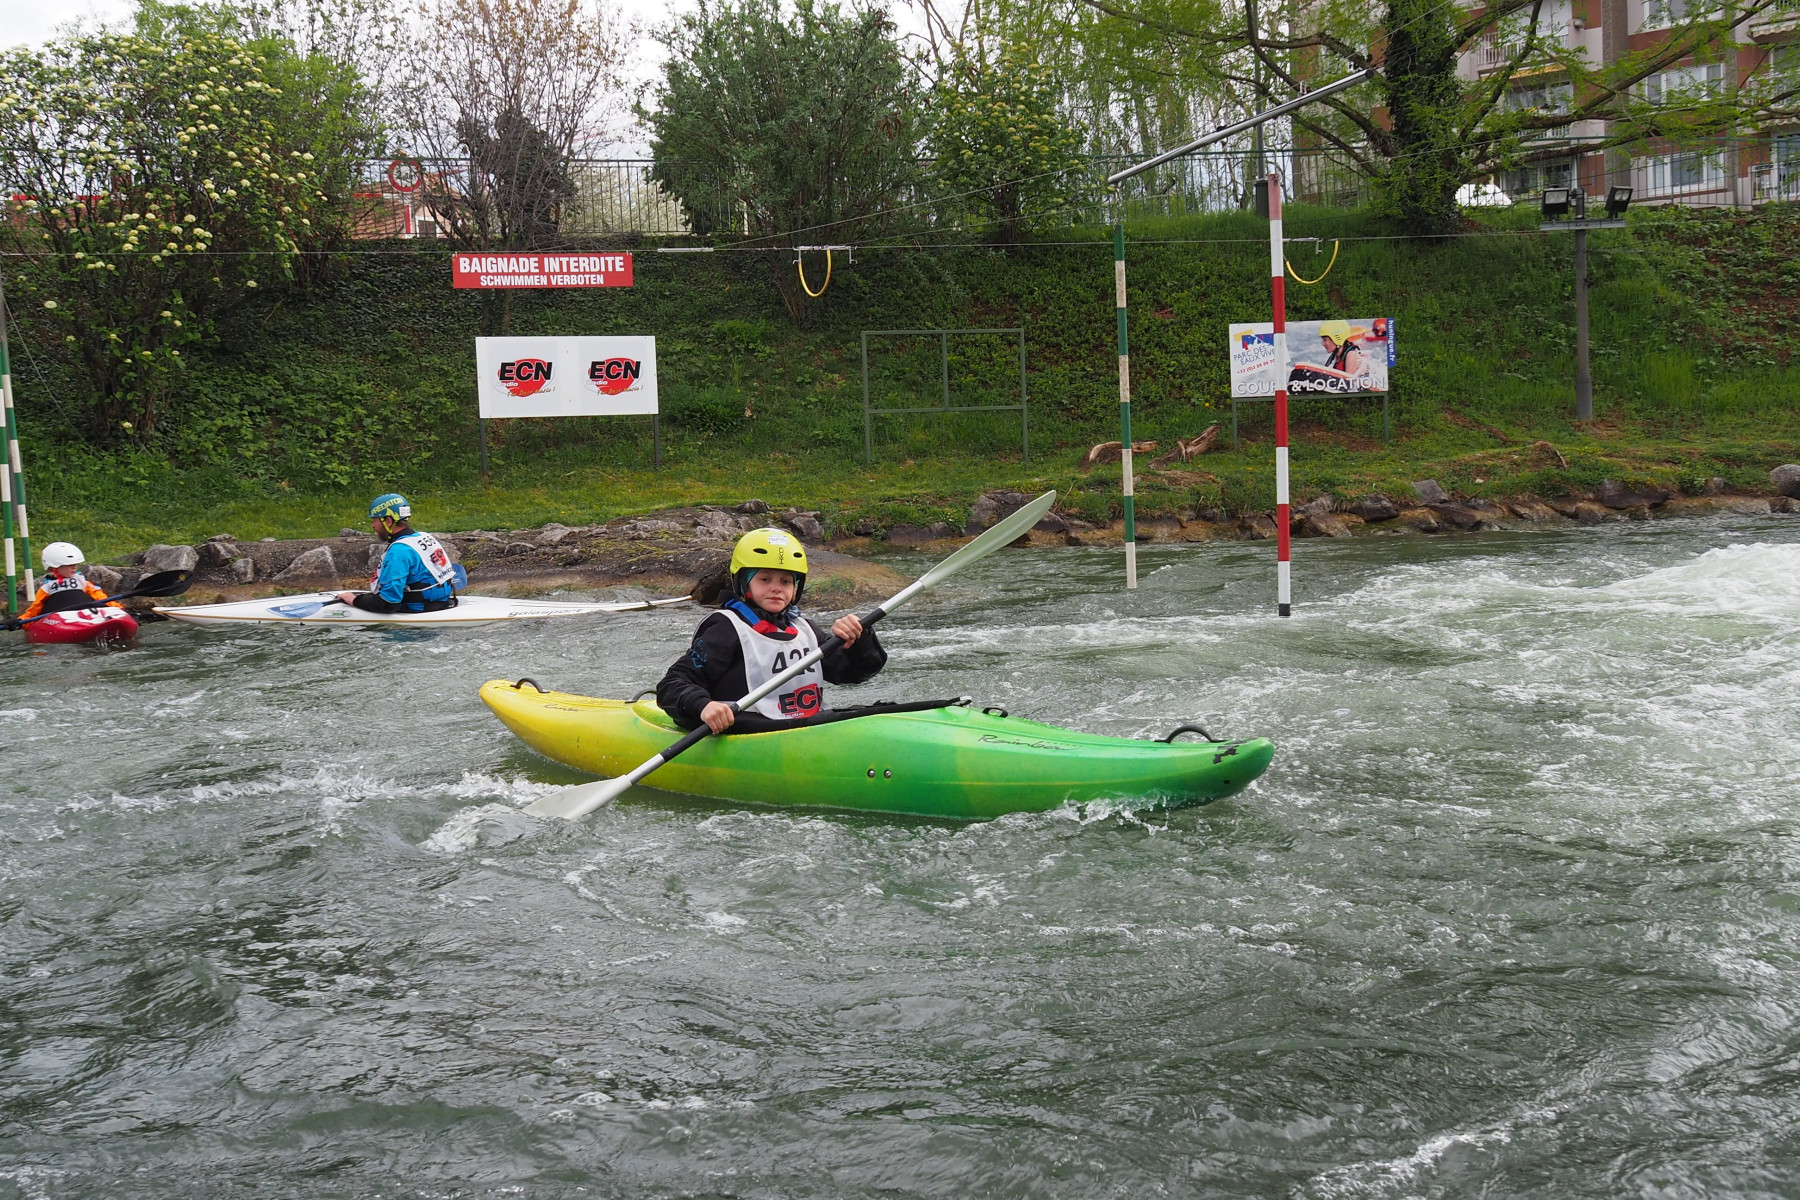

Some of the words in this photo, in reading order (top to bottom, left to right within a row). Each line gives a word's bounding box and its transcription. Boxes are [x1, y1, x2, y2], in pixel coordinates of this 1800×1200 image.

[459, 256, 540, 273] BAIGNADE
[543, 256, 625, 273] INTERDITE
[480, 275, 548, 286] SCHWIMMEN
[550, 274, 605, 286] VERBOTEN
[1388, 319, 1396, 362] huningue.fr
[1234, 349, 1252, 361] PARC
[1254, 345, 1267, 354] DES
[1240, 354, 1261, 365] EAUX
[499, 361, 553, 381] ECN
[589, 360, 642, 380] ECN
[1291, 380, 1302, 391] &
[1306, 376, 1385, 391] LOCATION
[370, 497, 405, 515] PREDATOR
[50, 577, 79, 592] 448
